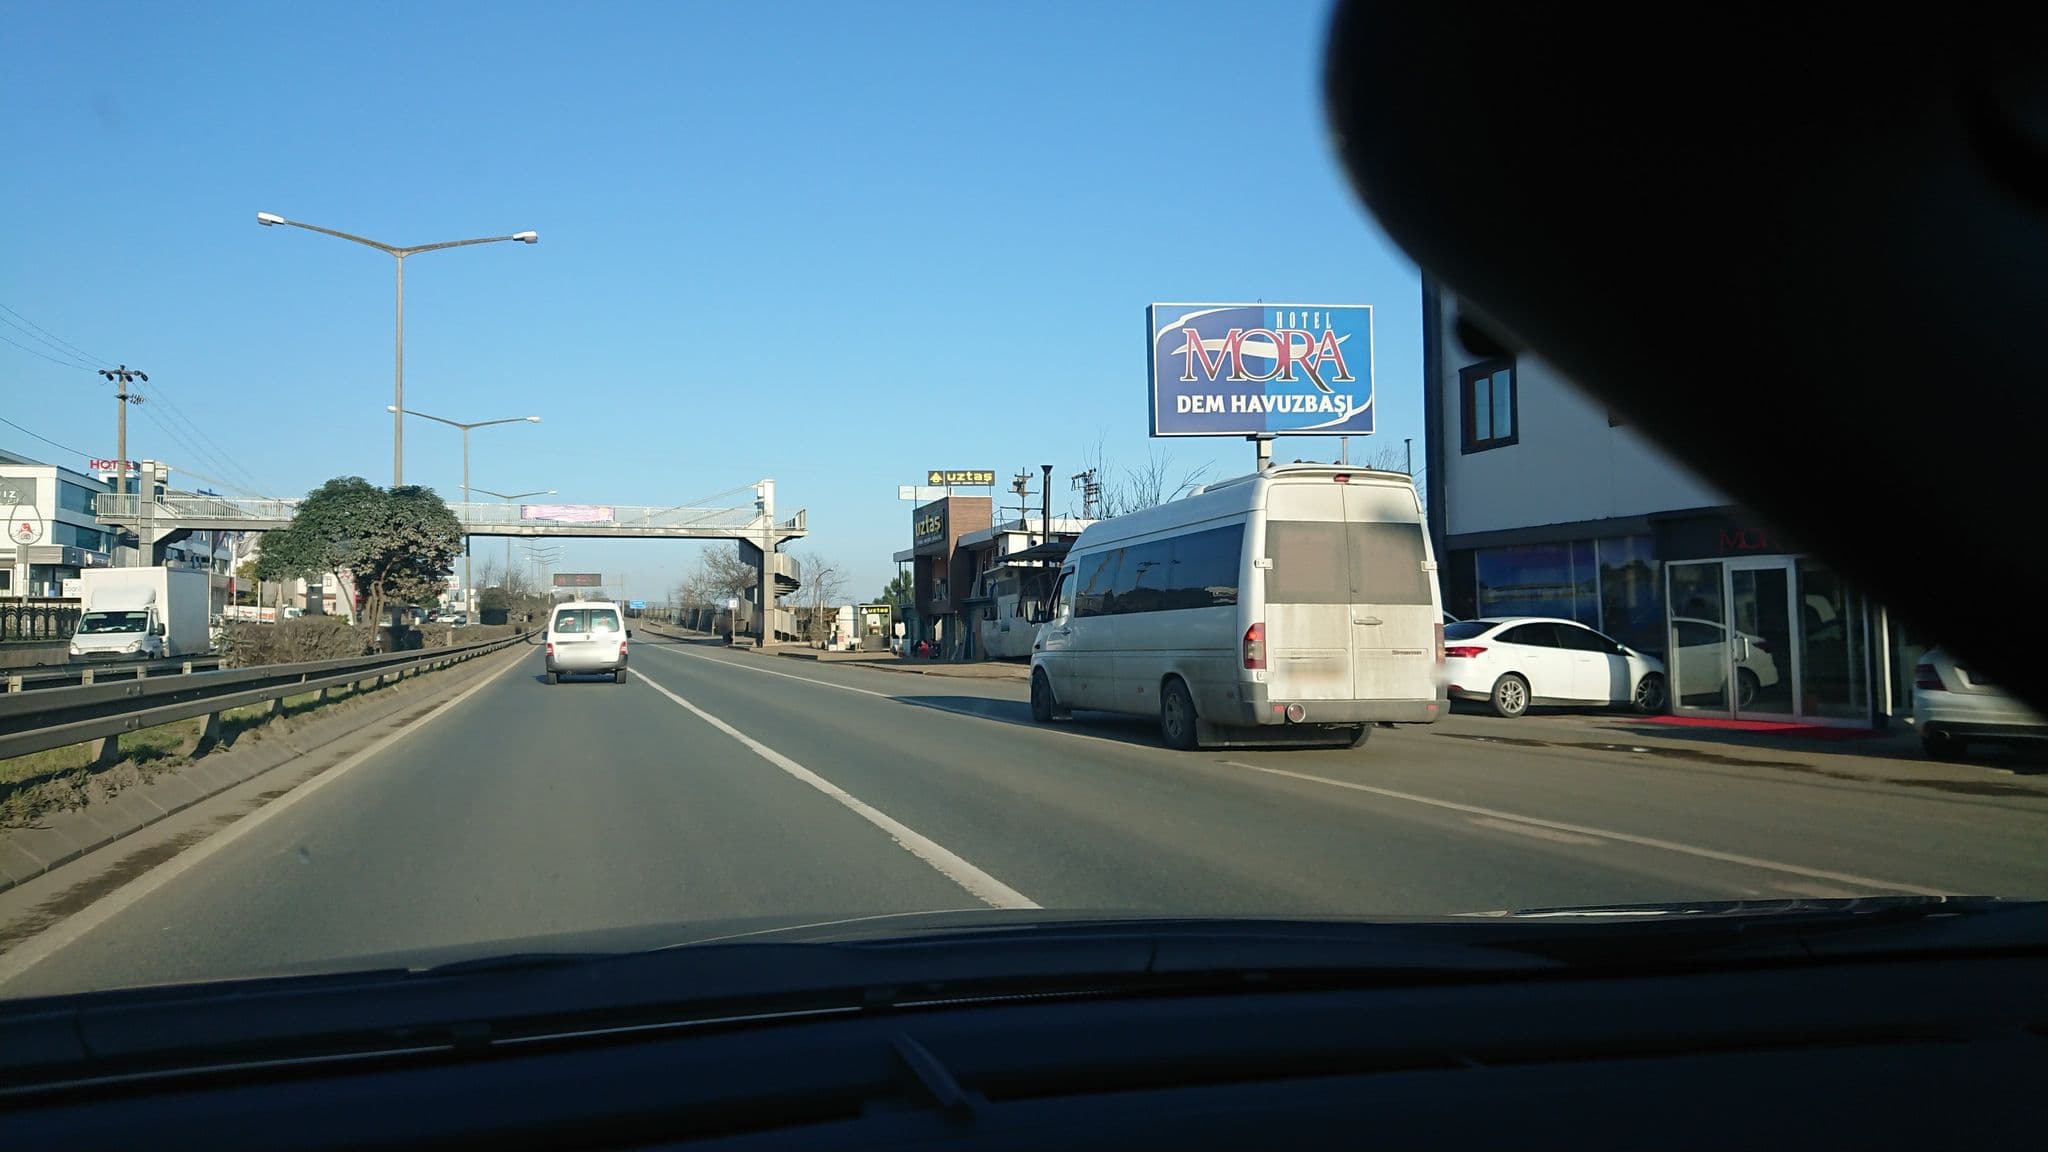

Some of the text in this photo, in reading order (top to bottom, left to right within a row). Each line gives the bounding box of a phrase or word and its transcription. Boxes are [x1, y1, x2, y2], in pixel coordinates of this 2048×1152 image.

[1276, 311, 1332, 329] HOTEL
[1179, 328, 1355, 393] MORA
[1177, 395, 1353, 417] DEM HAVUZBAŞI
